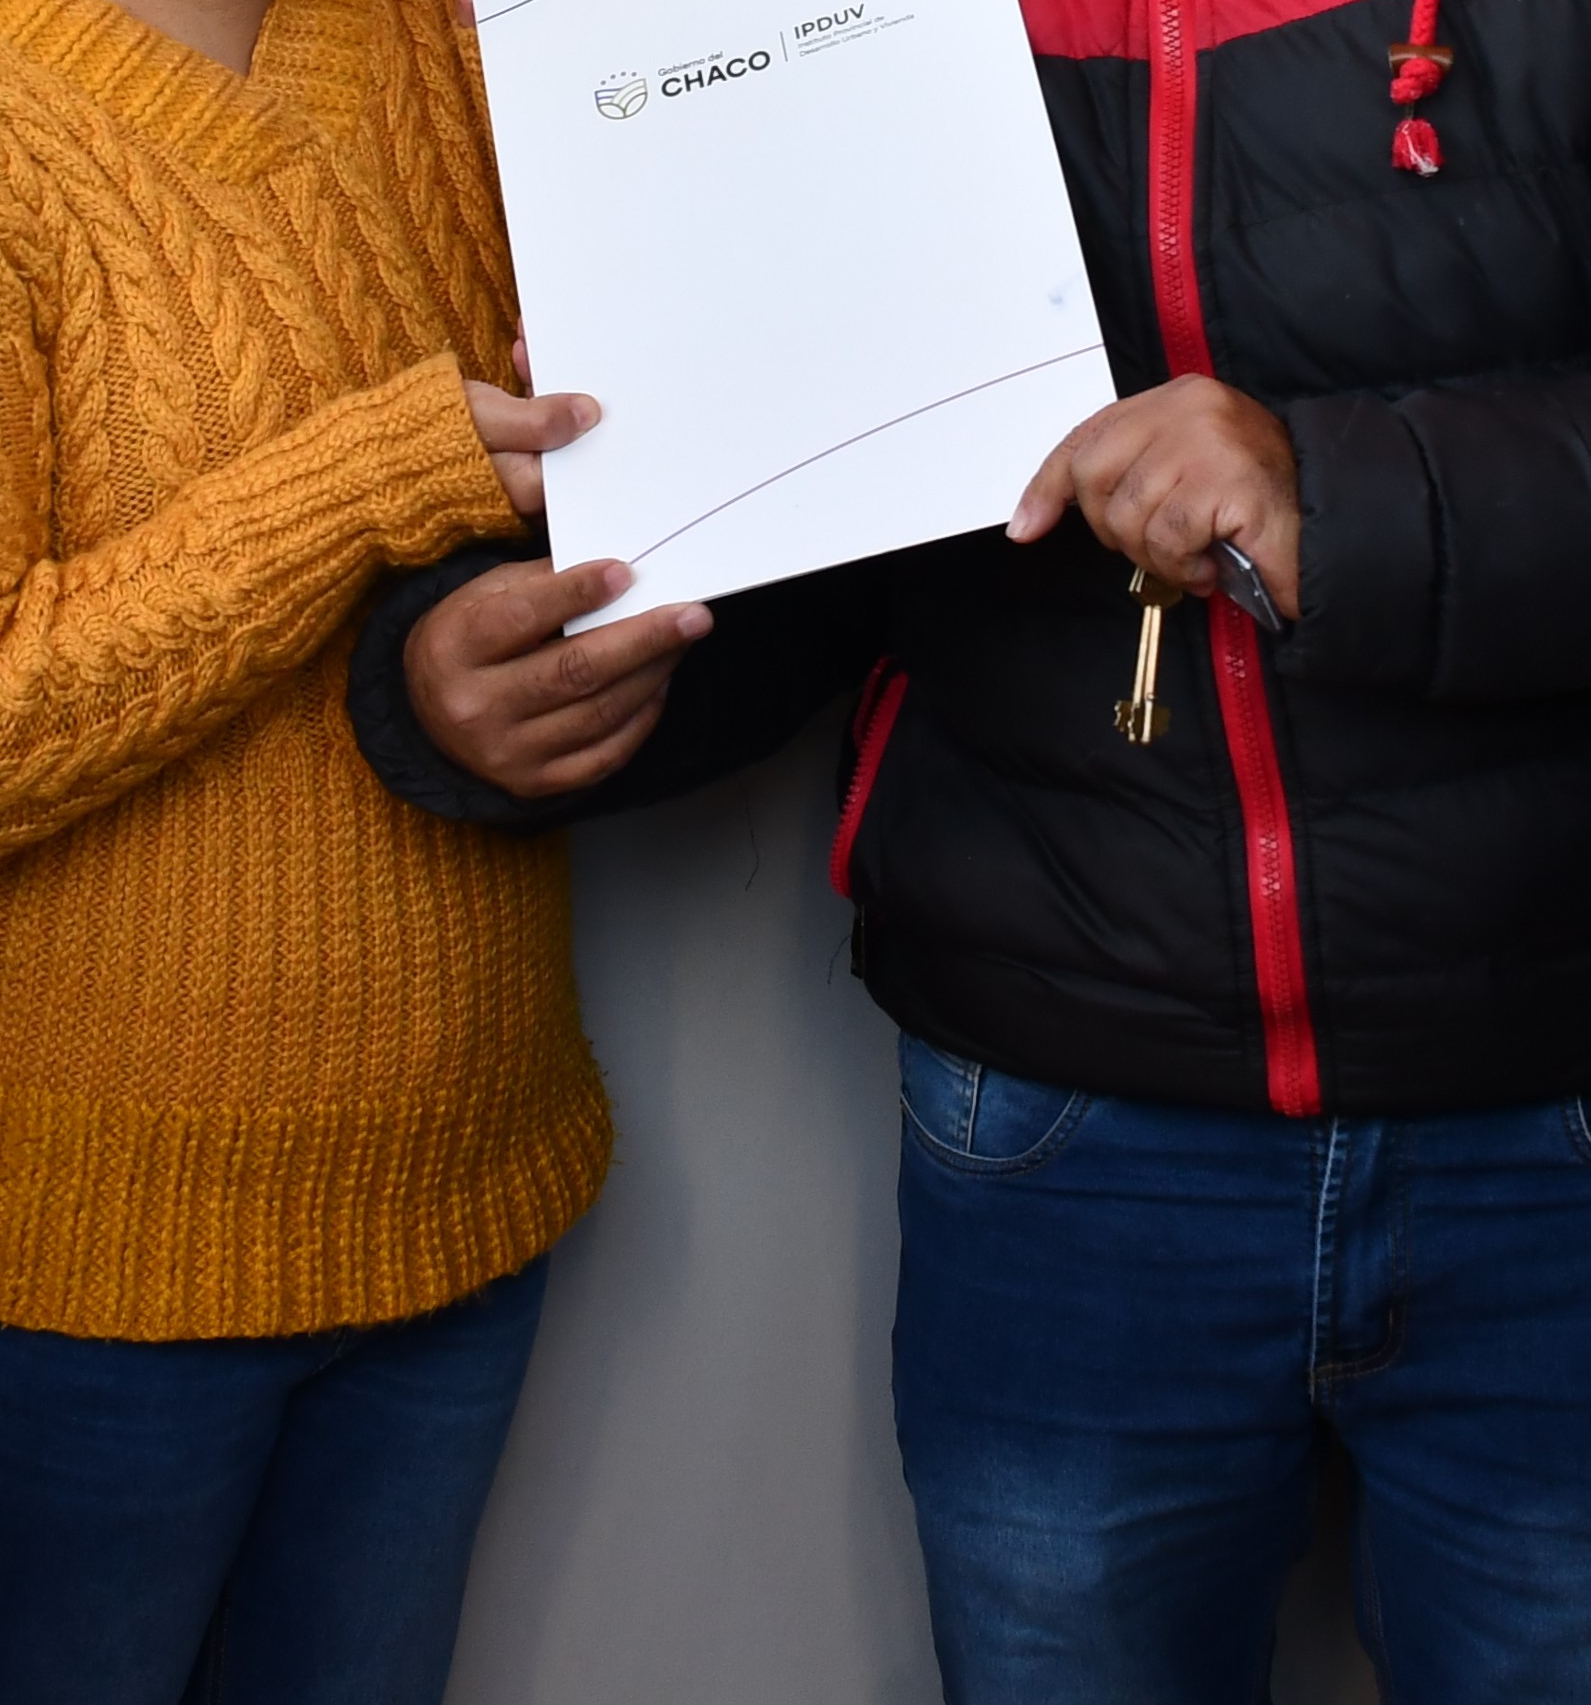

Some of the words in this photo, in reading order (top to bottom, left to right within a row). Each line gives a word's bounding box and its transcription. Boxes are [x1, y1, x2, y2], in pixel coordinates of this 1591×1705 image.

[794, 3, 865, 39] IPDUV
[657, 57, 706, 77] Gobierno
[707, 50, 724, 63] del
[660, 50, 771, 97] CHACO
